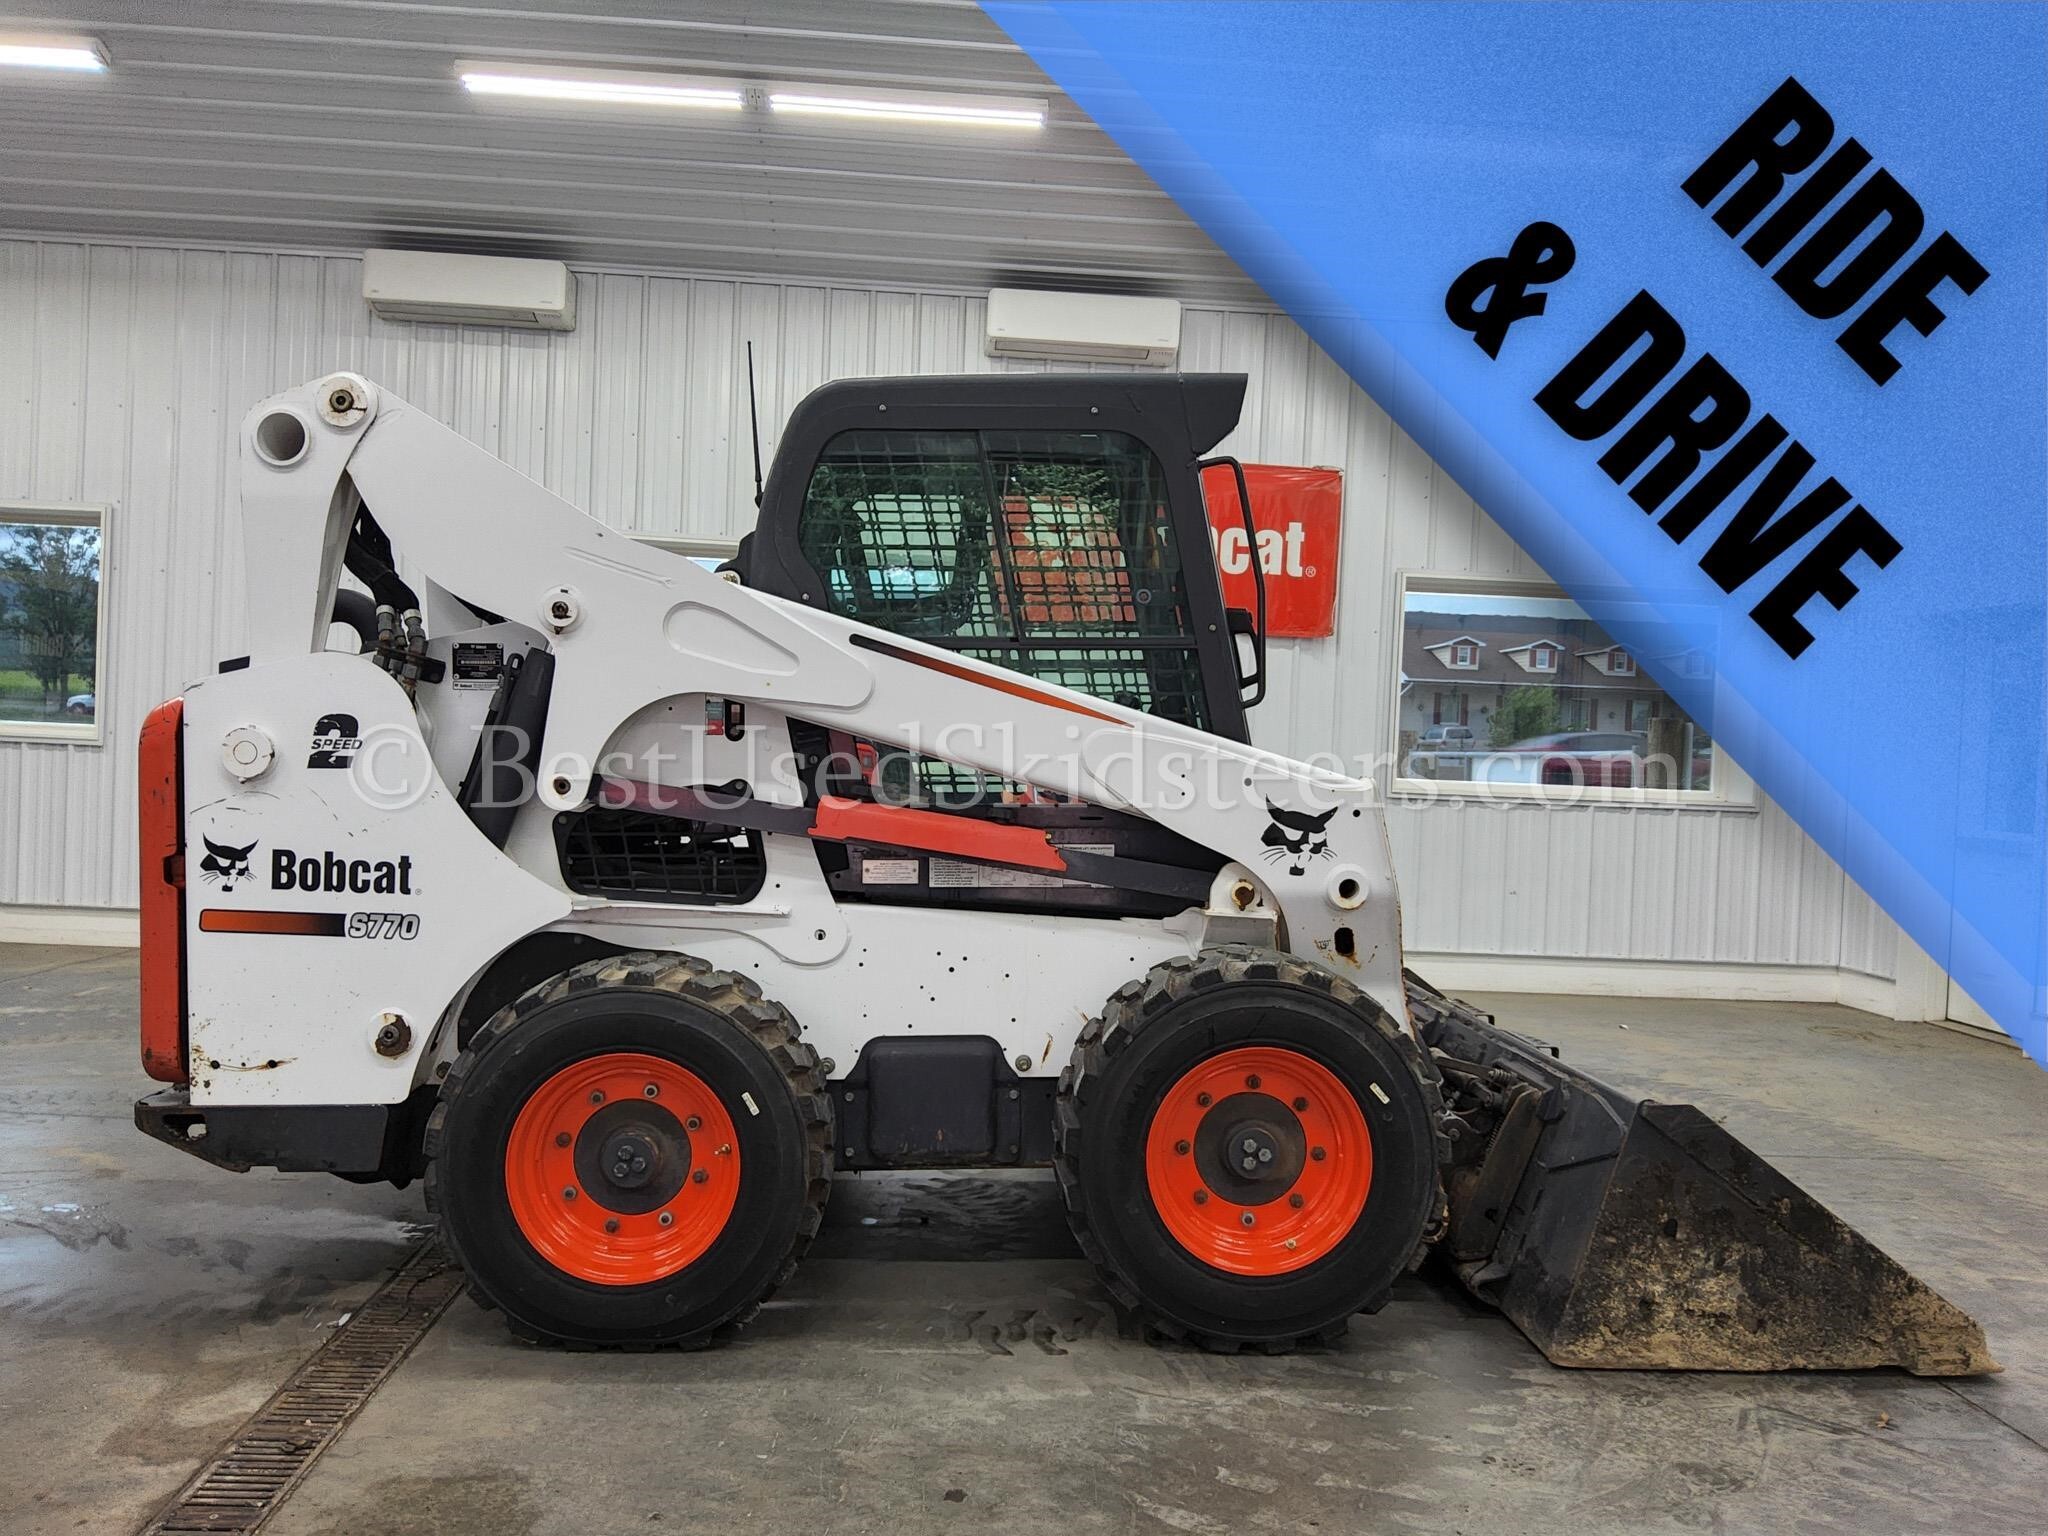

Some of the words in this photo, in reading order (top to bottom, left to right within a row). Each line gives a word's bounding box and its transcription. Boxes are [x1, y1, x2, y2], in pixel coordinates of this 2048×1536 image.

[1211, 522, 1305, 577] cat
[307, 713, 359, 769] 2
[311, 738, 363, 750] SPEED
[271, 848, 412, 895] Bobcat
[348, 911, 421, 940] S770
